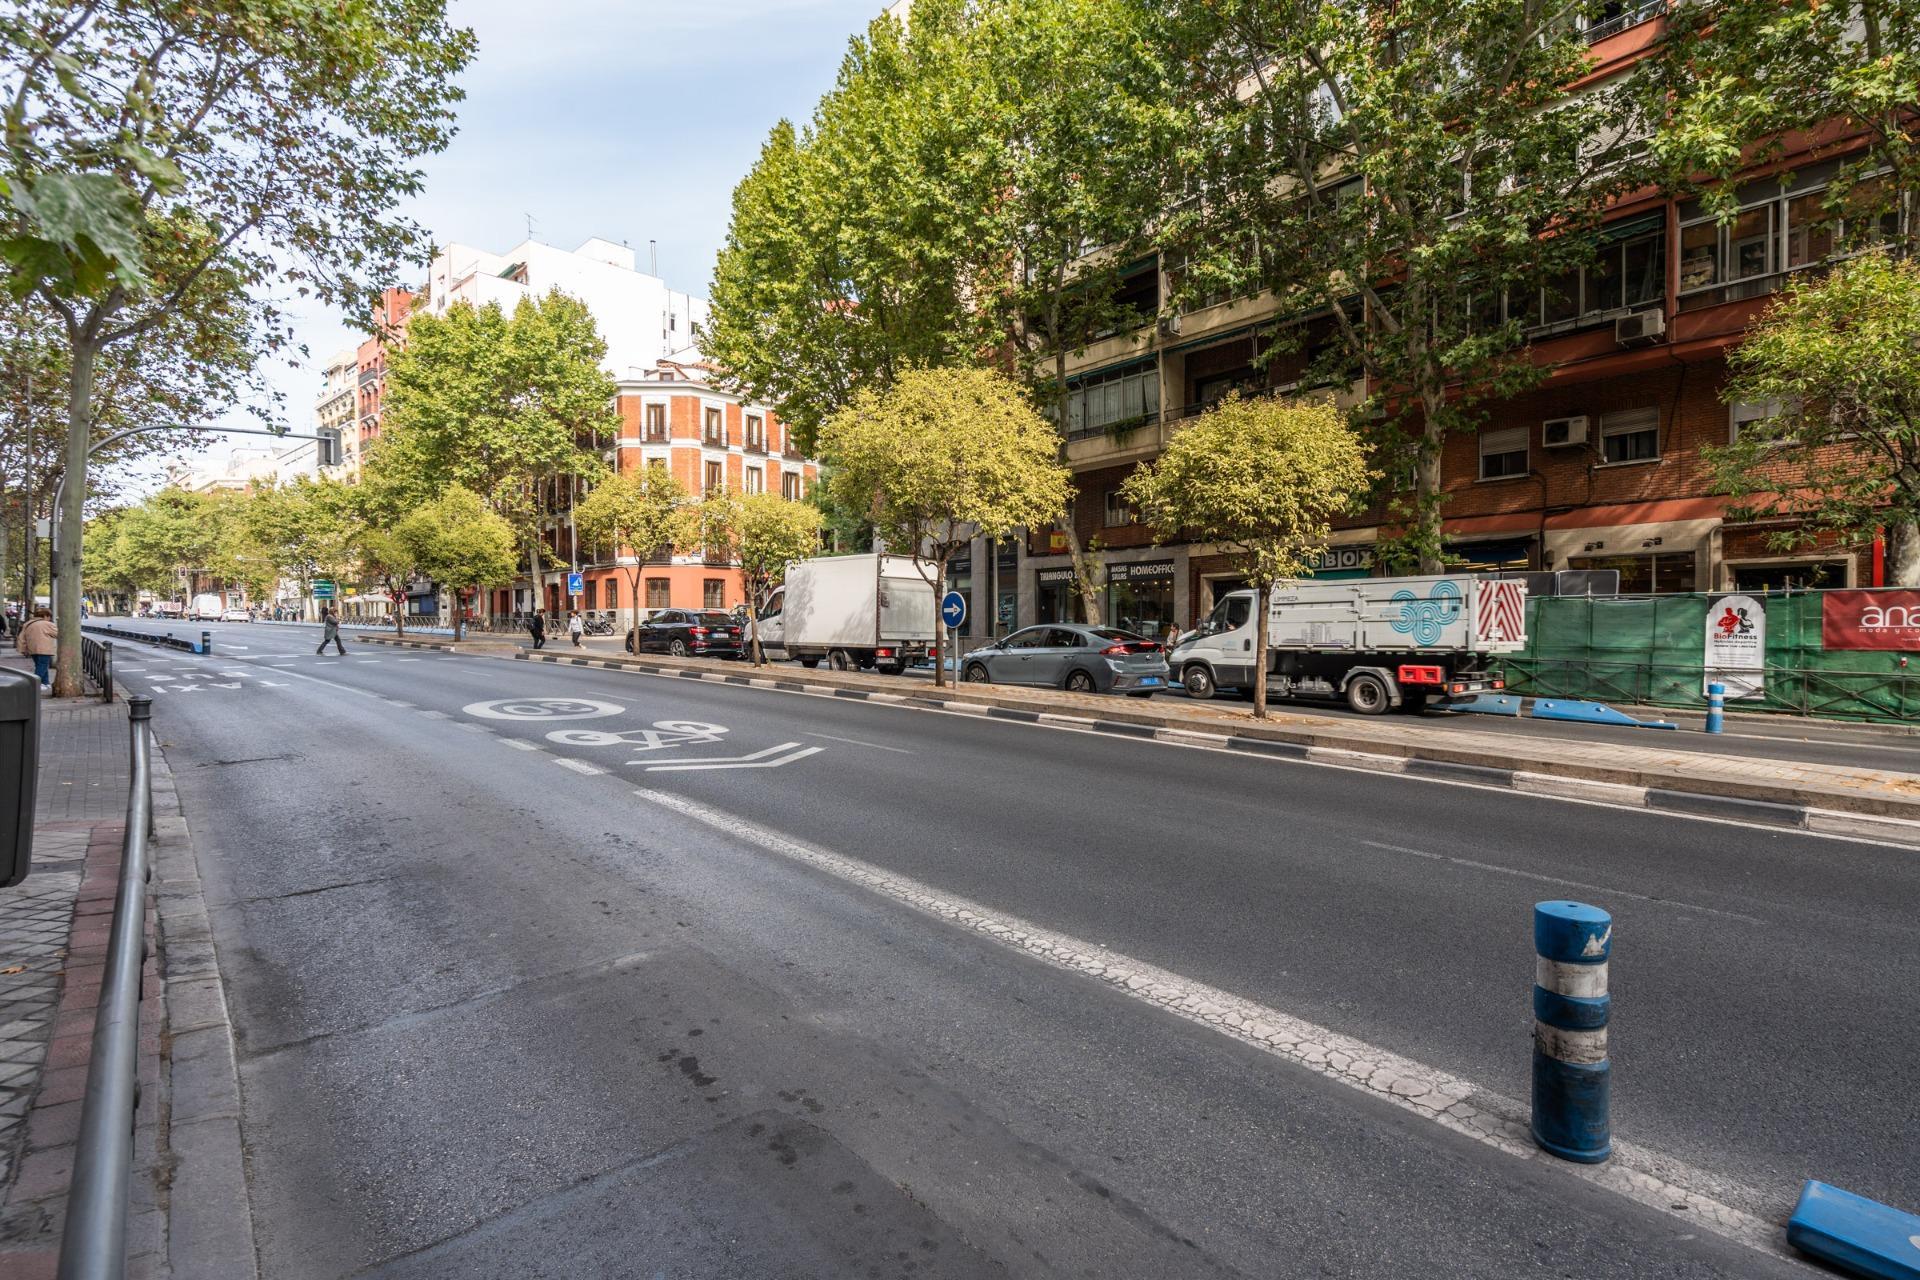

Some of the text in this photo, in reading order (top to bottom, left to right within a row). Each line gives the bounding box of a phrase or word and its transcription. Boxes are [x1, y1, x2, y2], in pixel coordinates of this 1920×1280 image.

[1039, 571, 1073, 581] TRIANGULO
[1130, 564, 1175, 576] HOMEOFFICE
[151, 680, 290, 693] TAXI
[502, 701, 594, 716] 30
